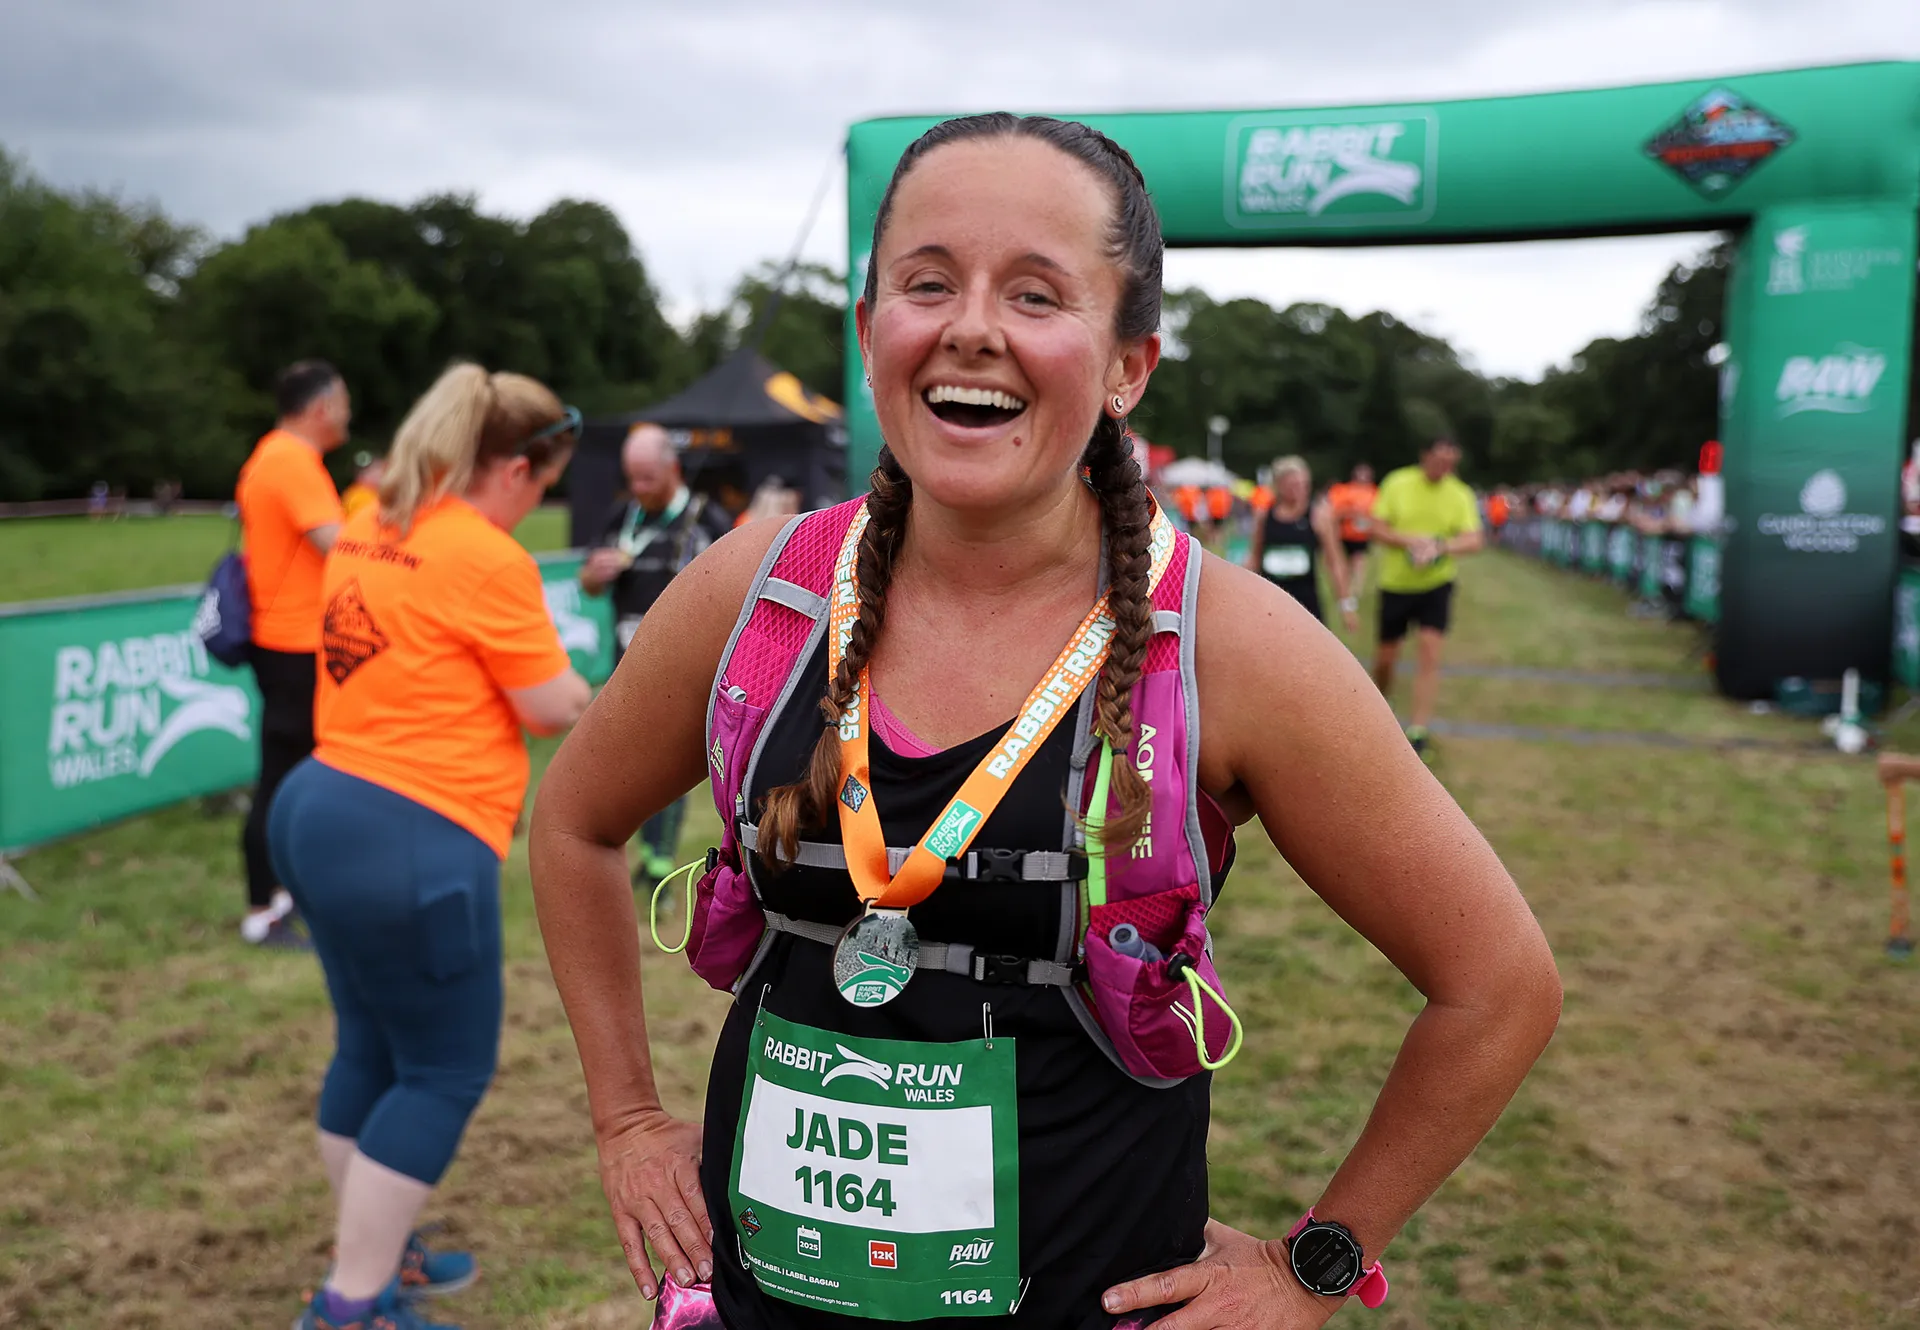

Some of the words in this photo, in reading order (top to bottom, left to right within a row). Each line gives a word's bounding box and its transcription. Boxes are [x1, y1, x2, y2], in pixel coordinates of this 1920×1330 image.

[1247, 122, 1405, 162] RABBIT
[1240, 160, 1334, 192] RUN
[56, 630, 209, 700] RABBIT
[986, 672, 1072, 780] RABBIT
[1062, 614, 1118, 677] RUN
[50, 684, 162, 754] RUN
[52, 744, 139, 789] WALES
[930, 807, 961, 849] RABBIT
[937, 829, 957, 856] RUN
[763, 1036, 833, 1074] RABBIT
[895, 1063, 964, 1087] RUN
[904, 1087, 956, 1103] WALES
[786, 1107, 909, 1166] JADE
[795, 1165, 898, 1217] 1164
[799, 1240, 819, 1251] 2025
[871, 1250, 895, 1261] 12K
[949, 1242, 994, 1261] R4W
[761, 1260, 782, 1274] LABEL
[785, 1269, 809, 1282] LABEL
[809, 1276, 840, 1288] BAGIAU
[940, 1288, 993, 1305] 1164
